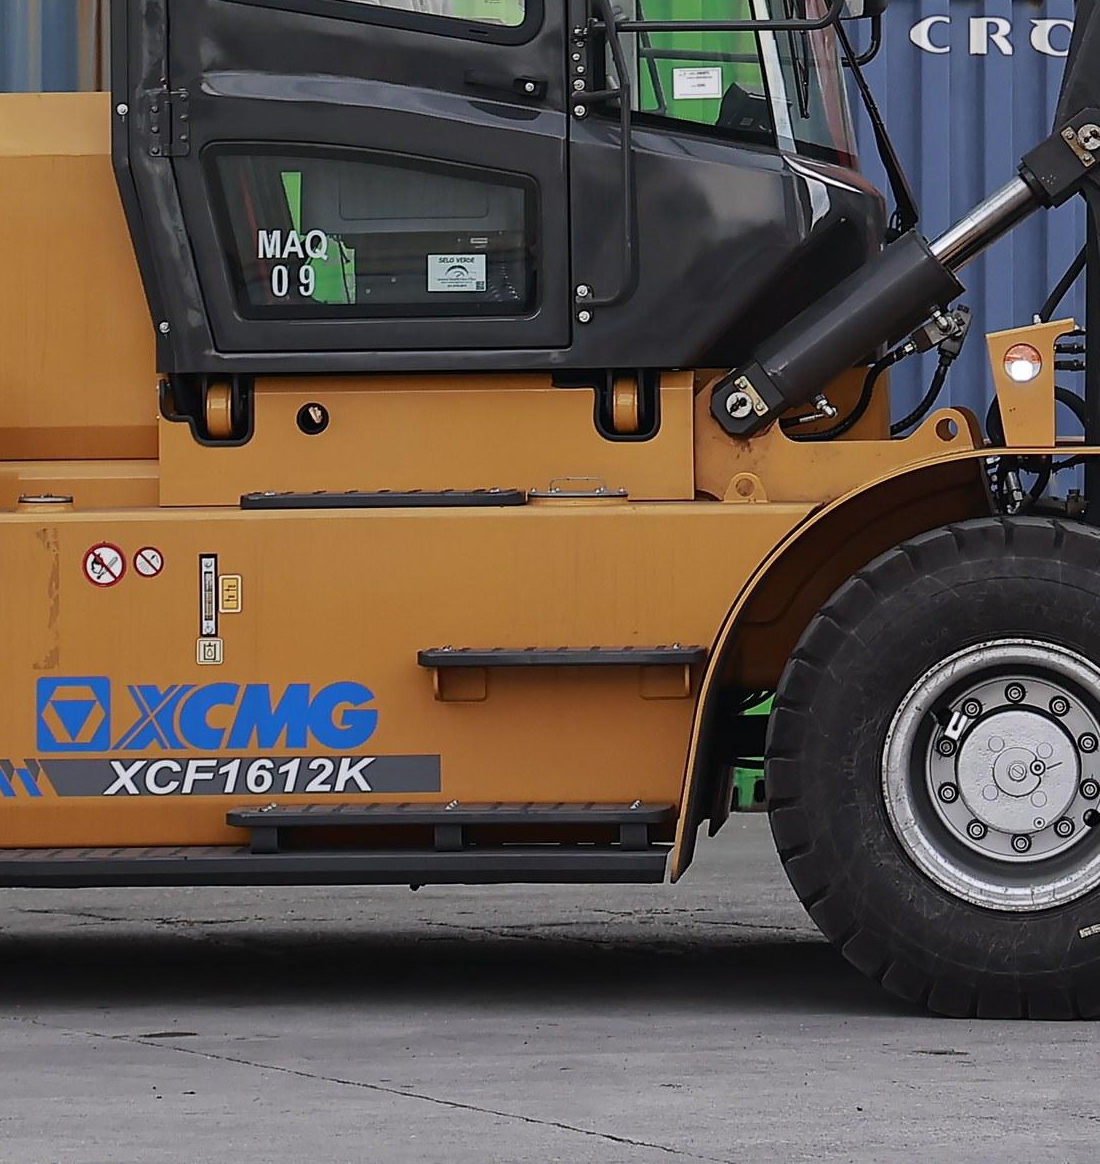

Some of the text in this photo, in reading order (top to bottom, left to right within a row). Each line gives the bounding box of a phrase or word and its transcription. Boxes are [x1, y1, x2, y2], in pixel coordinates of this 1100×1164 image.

[257, 230, 328, 260] MAQ
[111, 681, 379, 750] XCMG
[103, 756, 377, 796] XCF1612K
